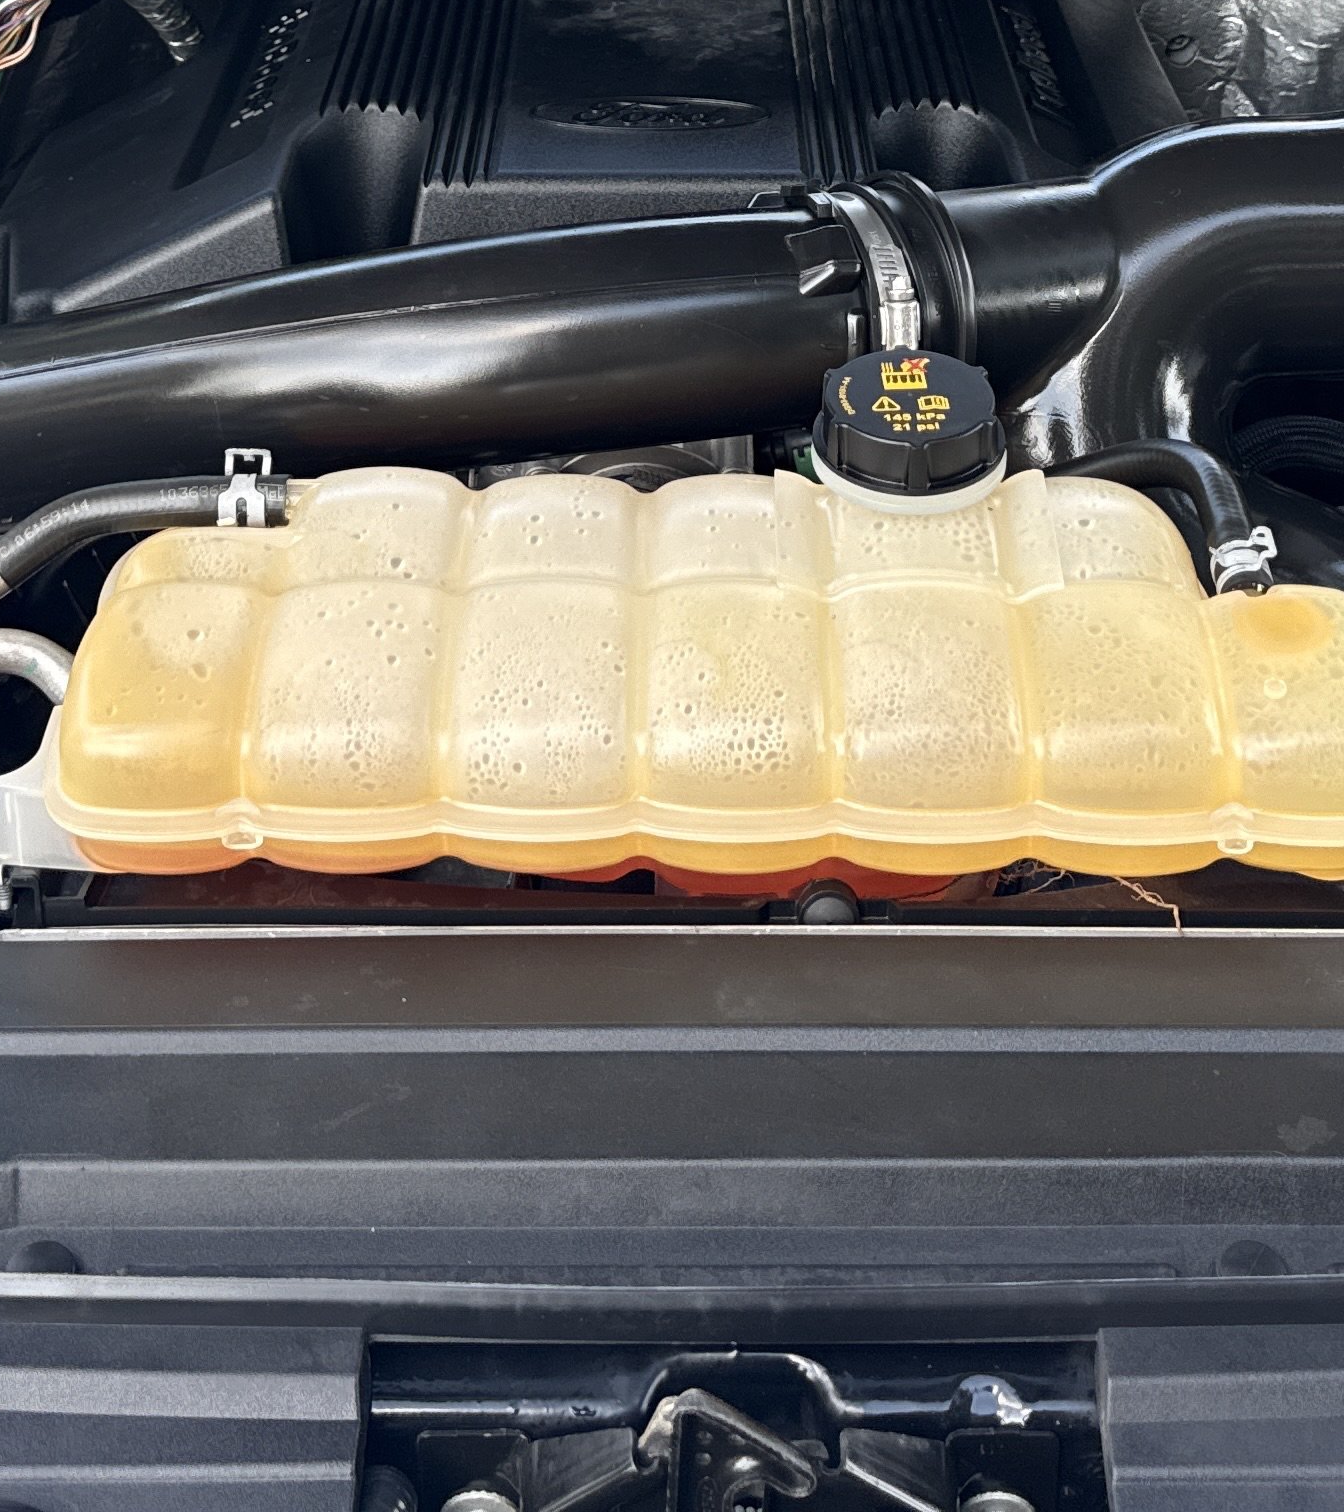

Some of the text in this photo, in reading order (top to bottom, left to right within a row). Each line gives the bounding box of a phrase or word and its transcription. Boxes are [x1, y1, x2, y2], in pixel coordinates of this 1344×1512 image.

[884, 412, 946, 422] 145 kPa
[892, 422, 941, 432] 21 psi
